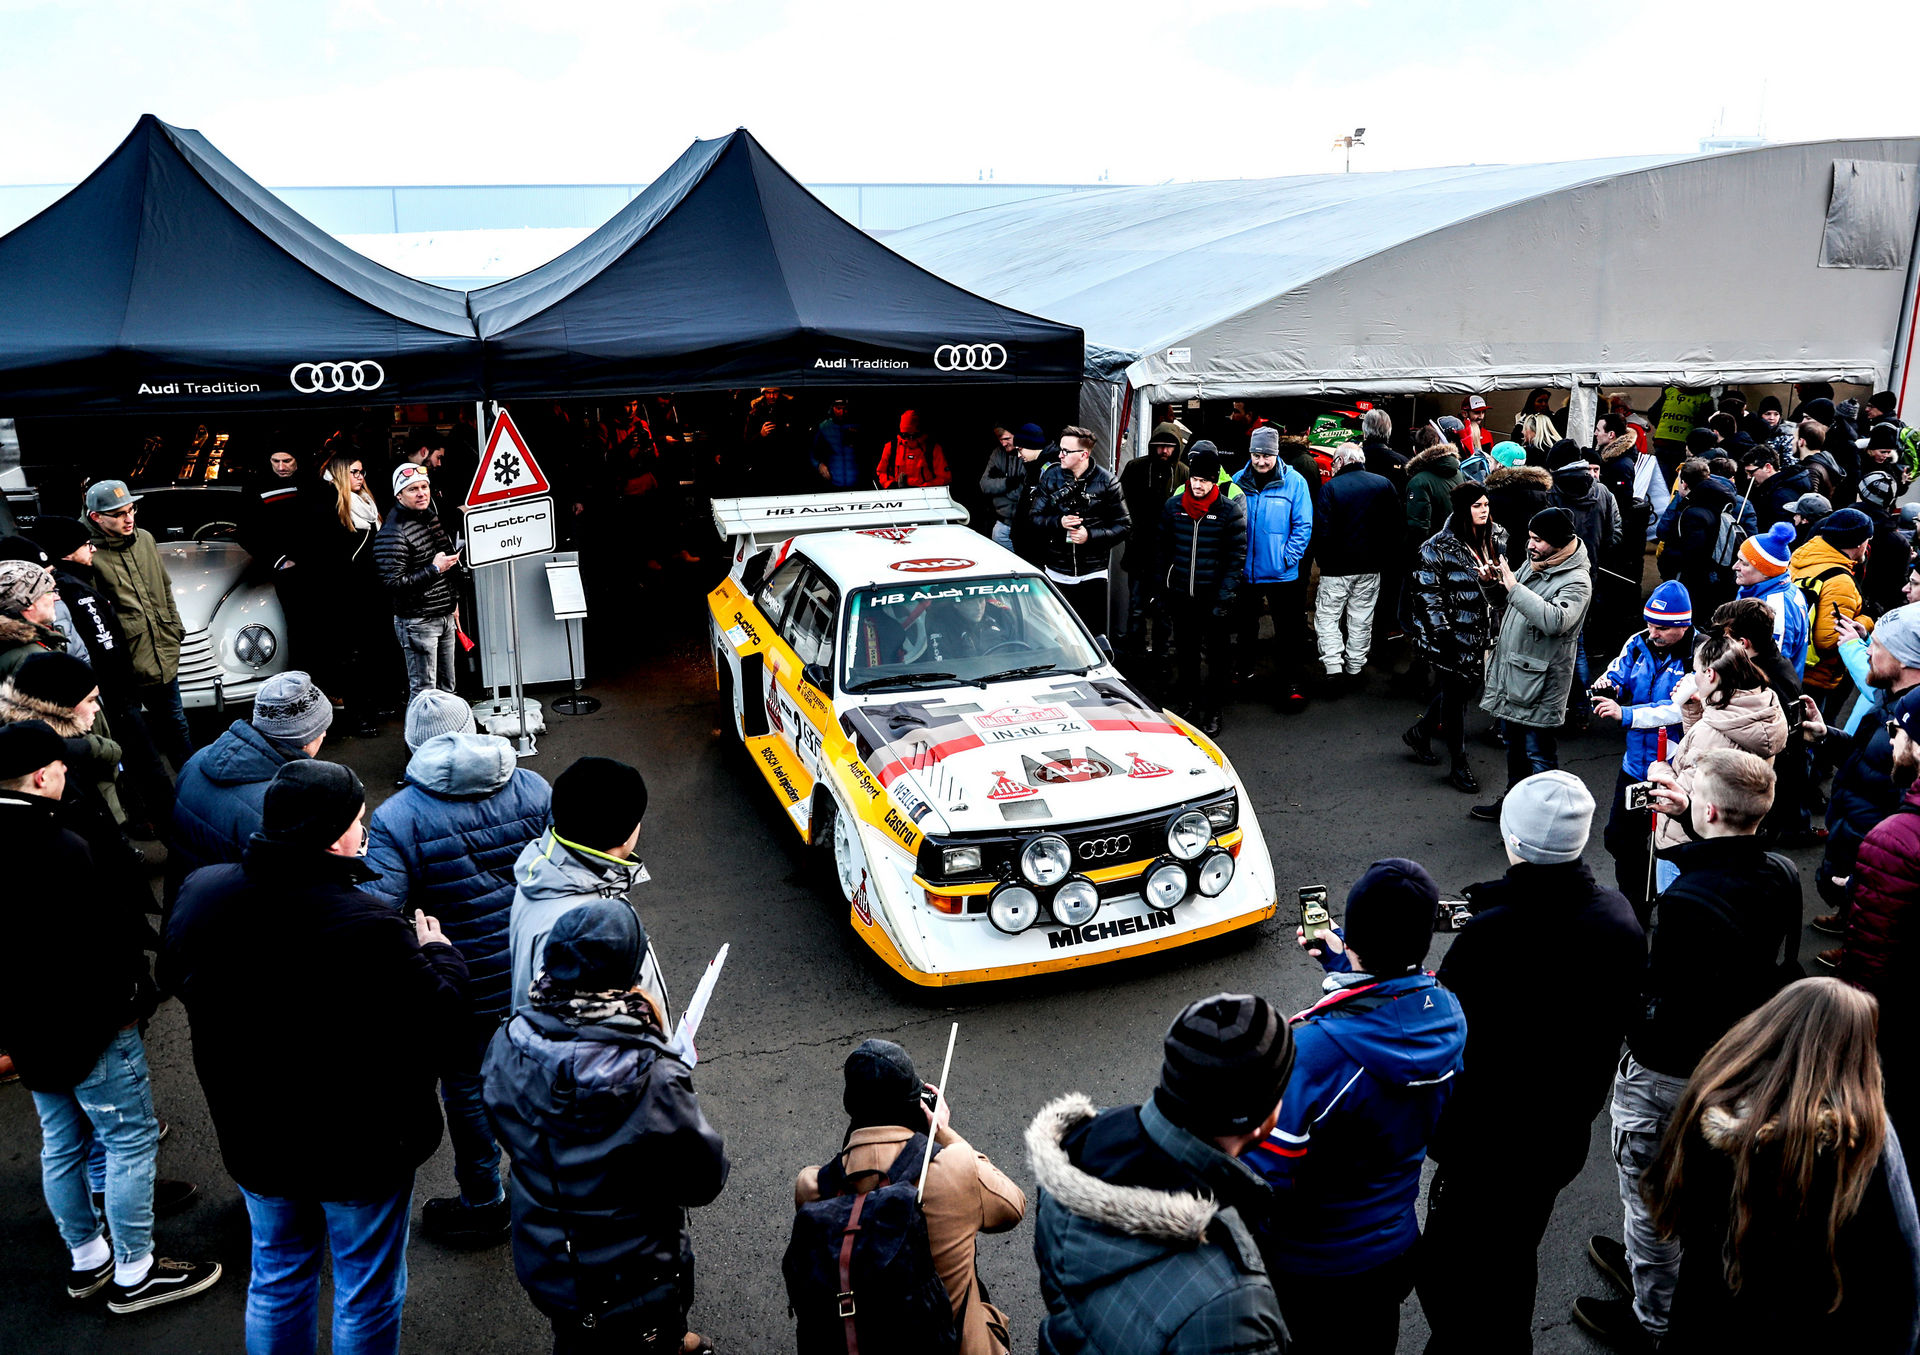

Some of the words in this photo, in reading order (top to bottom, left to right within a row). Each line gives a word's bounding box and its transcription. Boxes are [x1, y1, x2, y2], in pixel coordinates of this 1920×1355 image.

[814, 358, 847, 369] Audi
[850, 358, 909, 369] Tradition
[138, 382, 180, 395] Audi
[184, 382, 260, 394] Tradition
[1668, 424, 1686, 434] 167
[766, 507, 795, 516] HB
[849, 501, 903, 512] TEAM
[473, 512, 547, 532] quattro
[500, 535, 522, 548] only
[897, 558, 971, 573] Audi
[870, 593, 905, 608] HB
[965, 583, 1030, 595] TEAM
[734, 611, 761, 646] quattro
[1057, 722, 1081, 732] 24
[794, 711, 805, 764] 2
[761, 747, 779, 768] BOSCH
[779, 775, 800, 803] injection
[1046, 761, 1105, 781] Audi
[1133, 761, 1158, 774] HB
[848, 761, 863, 779] Audi
[860, 775, 880, 800] Sport
[994, 781, 1024, 795] HB
[884, 808, 917, 847] Castrol
[1048, 909, 1176, 948] MICHELIN
